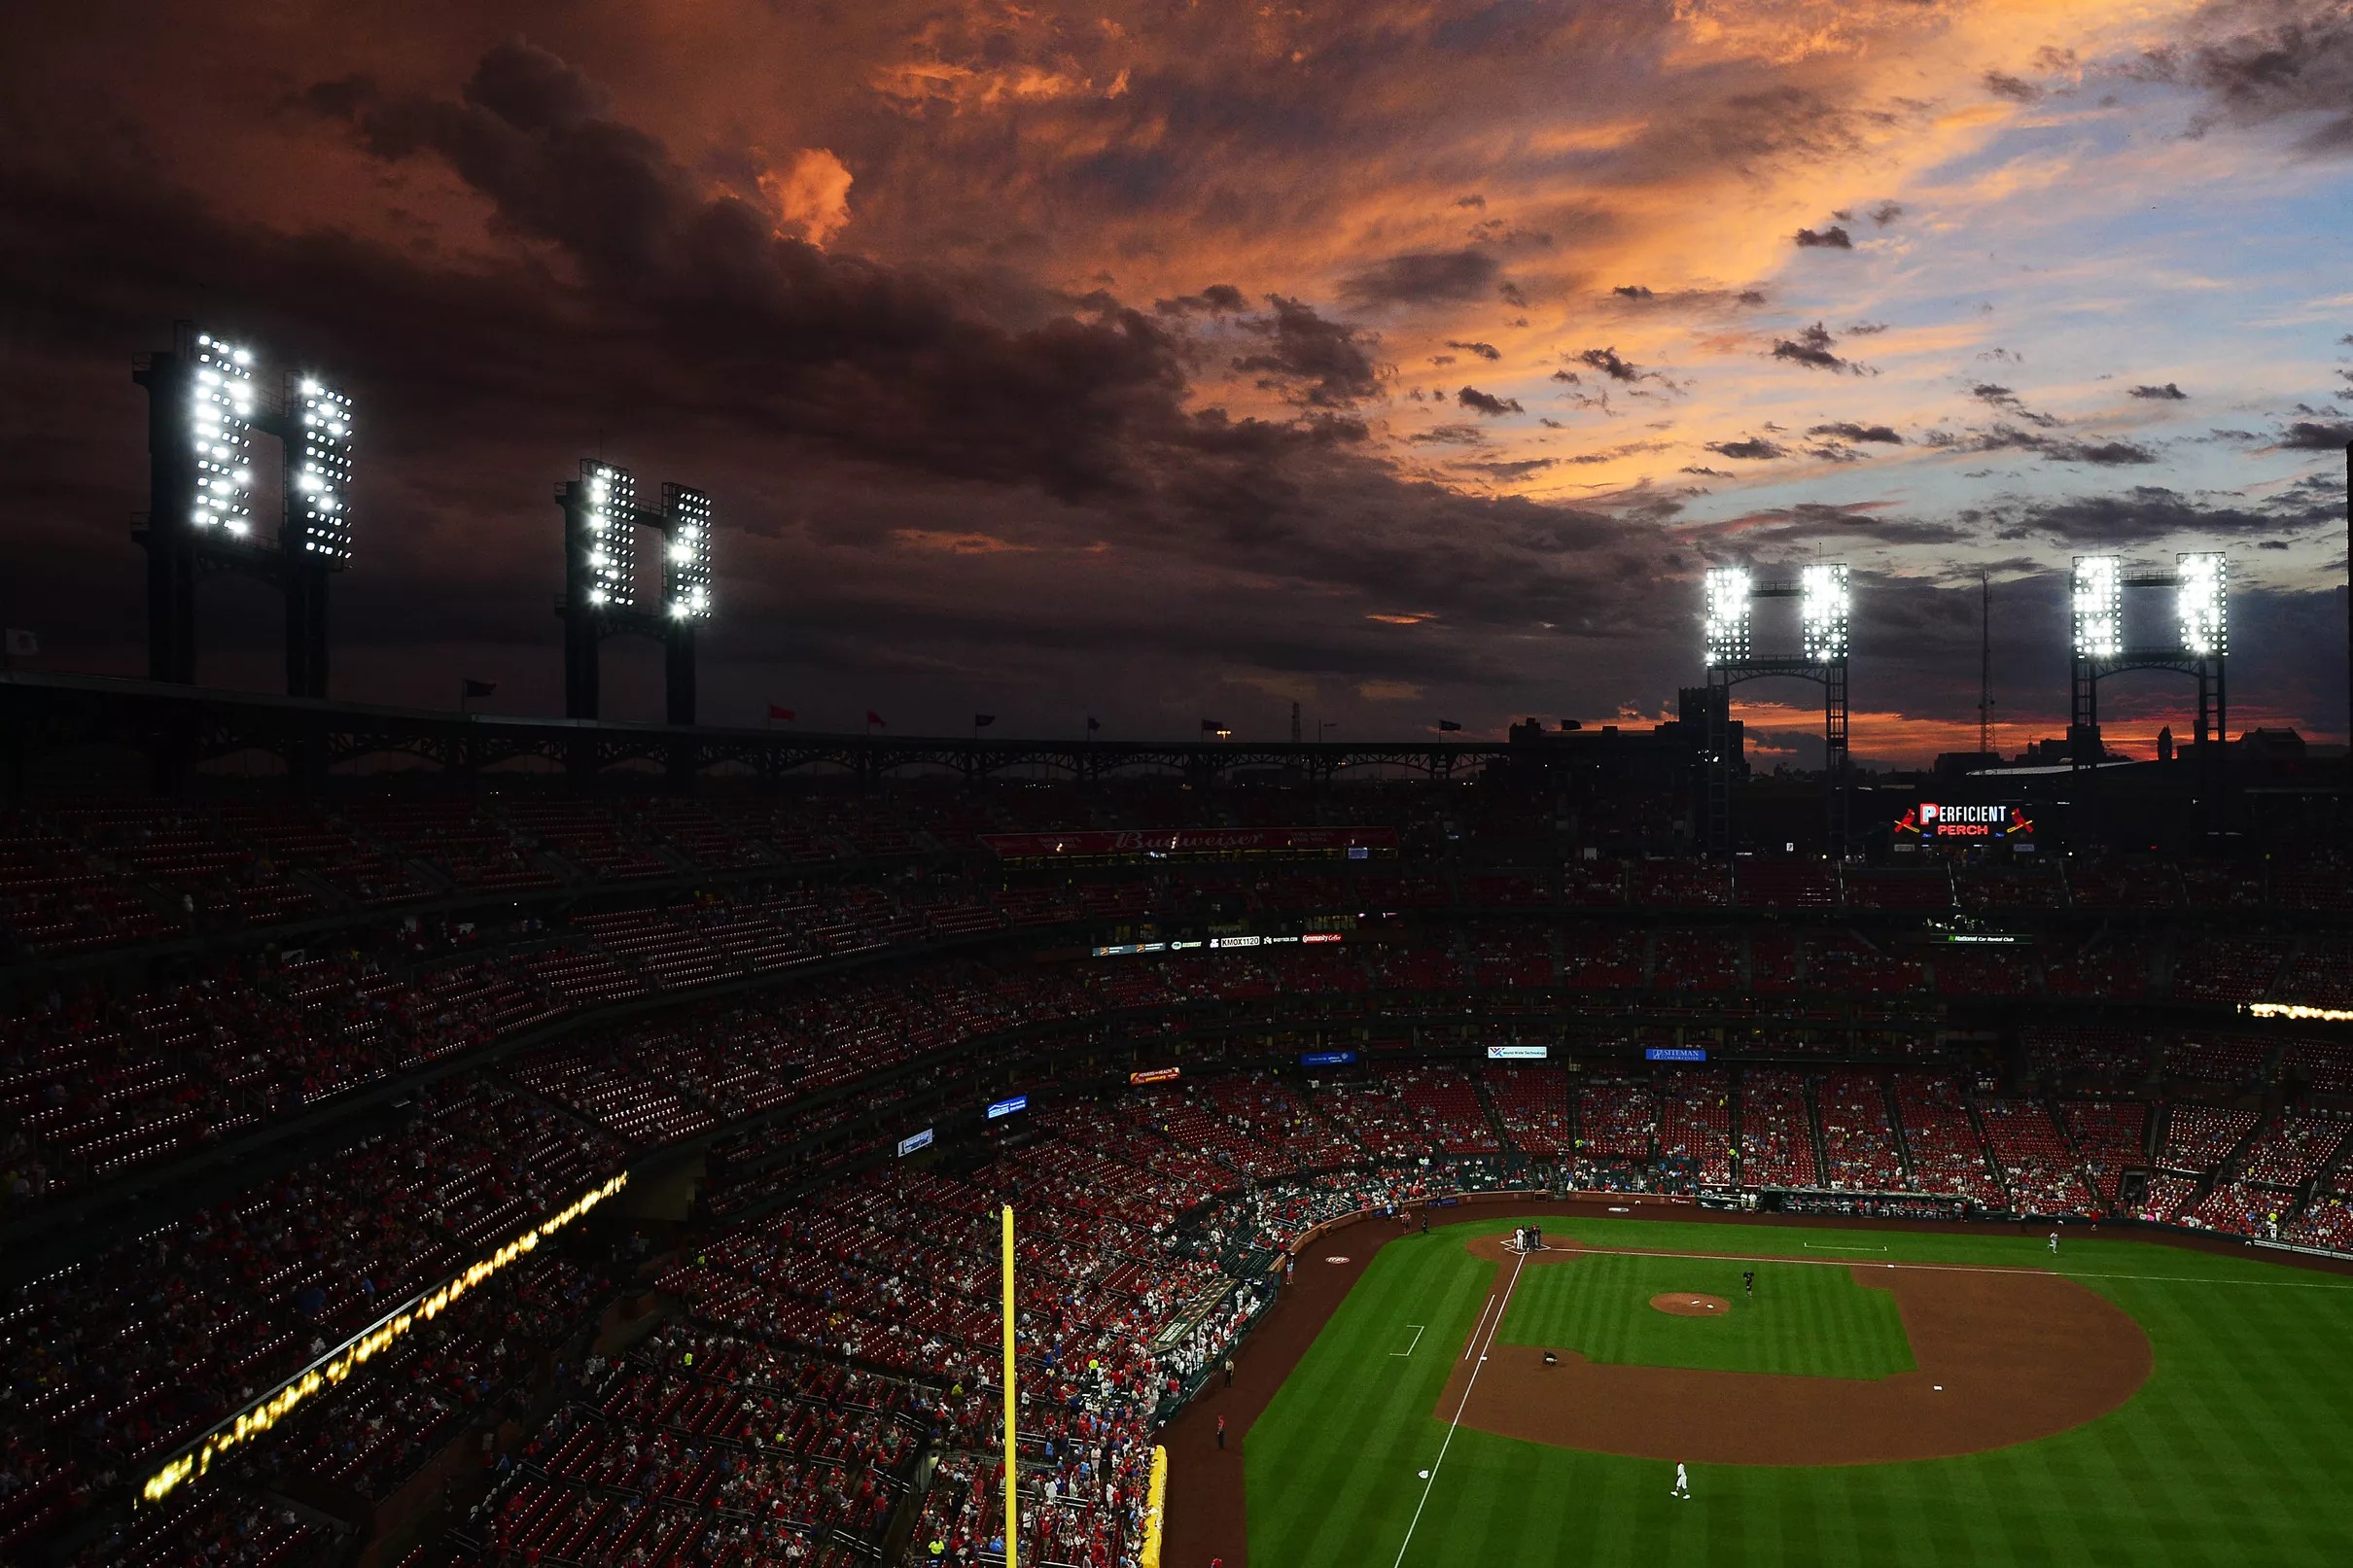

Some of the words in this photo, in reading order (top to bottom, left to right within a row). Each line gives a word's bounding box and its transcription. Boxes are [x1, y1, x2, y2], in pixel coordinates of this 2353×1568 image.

[1919, 802, 2007, 825] PERFICIENT
[1937, 824, 1988, 836] PERCH
[1115, 831, 1265, 849] Budweiser
